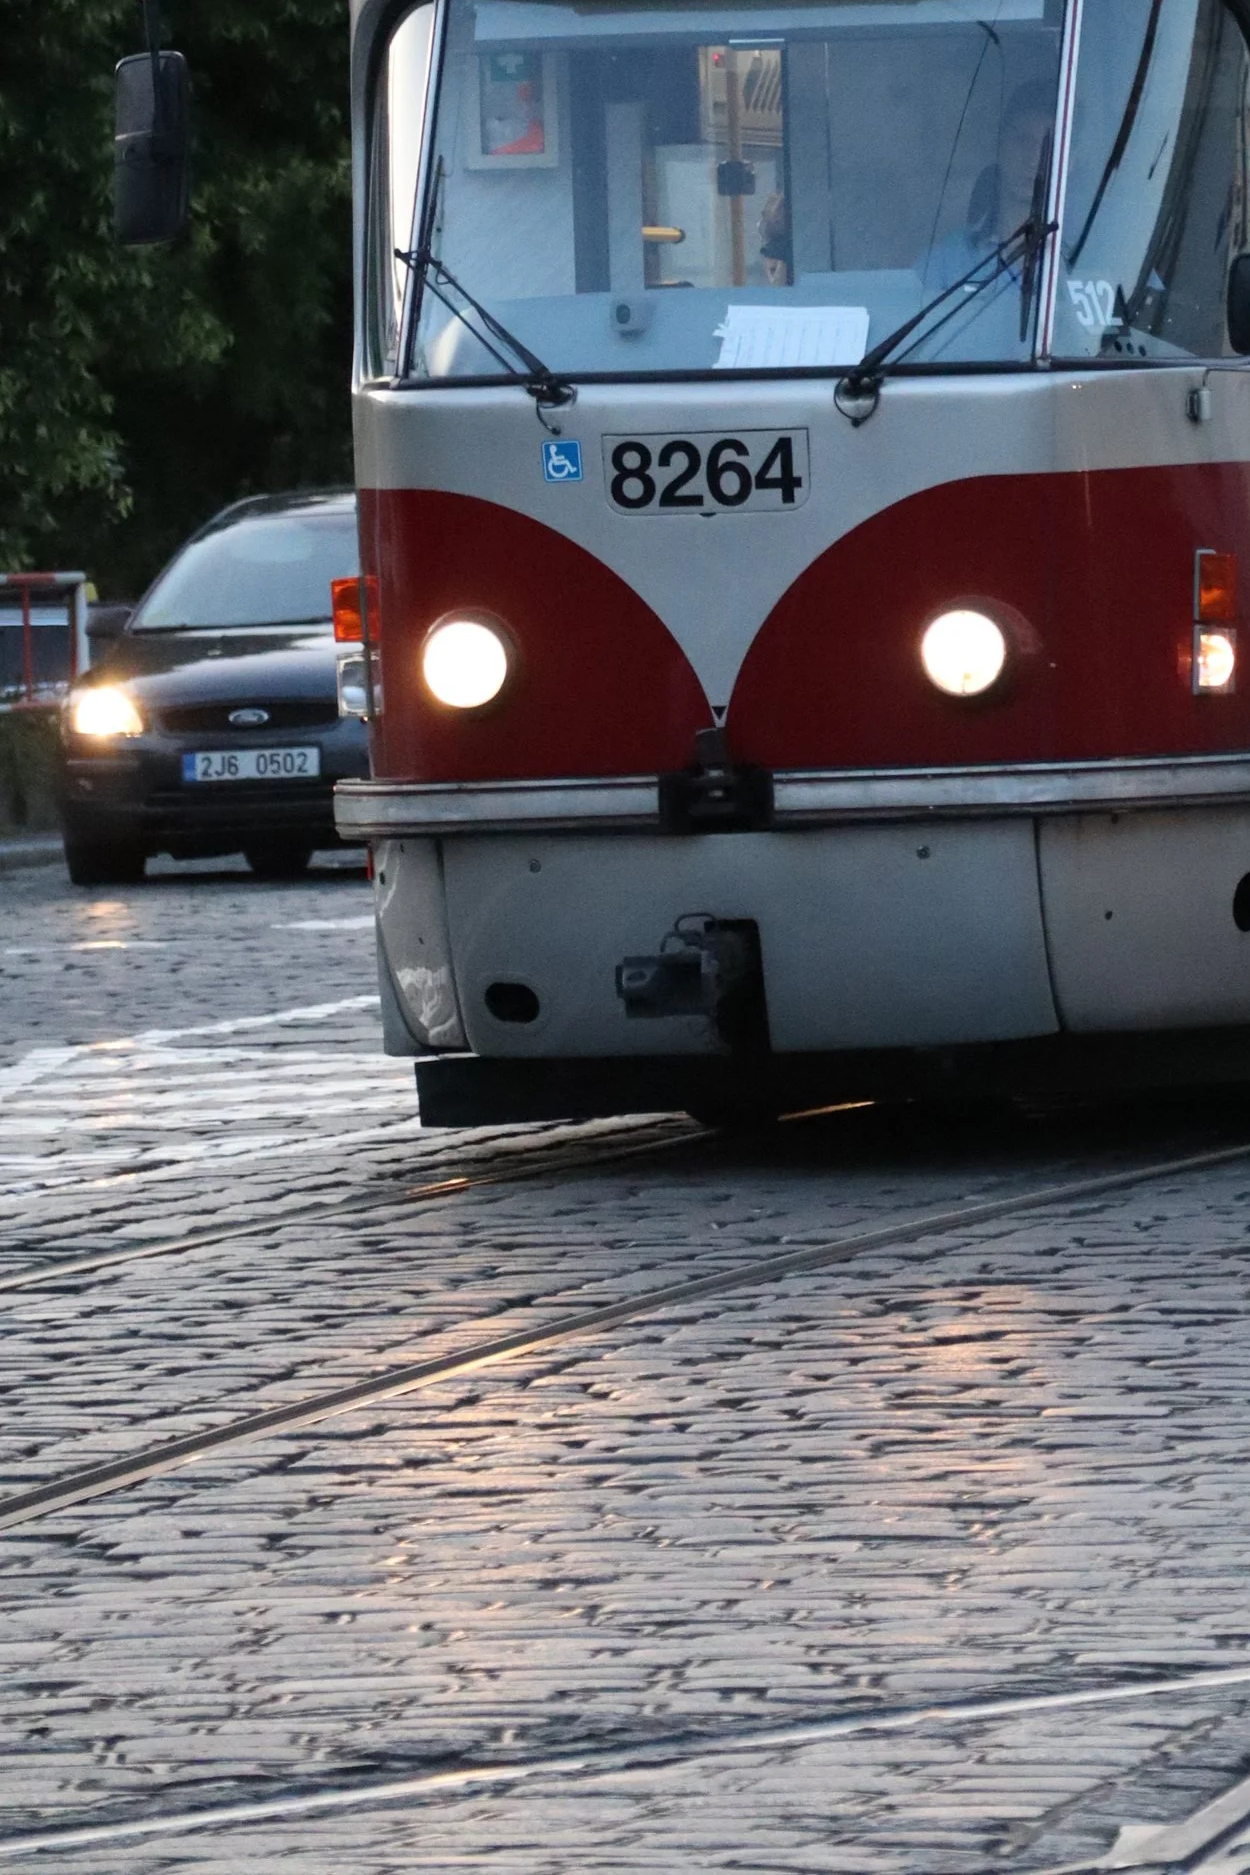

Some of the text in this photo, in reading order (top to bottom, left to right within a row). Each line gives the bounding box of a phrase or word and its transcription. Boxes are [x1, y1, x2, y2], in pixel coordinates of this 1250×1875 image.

[1066, 279, 1124, 327] 512
[610, 437, 803, 509] 8264
[201, 752, 308, 777] 2J6 0502
